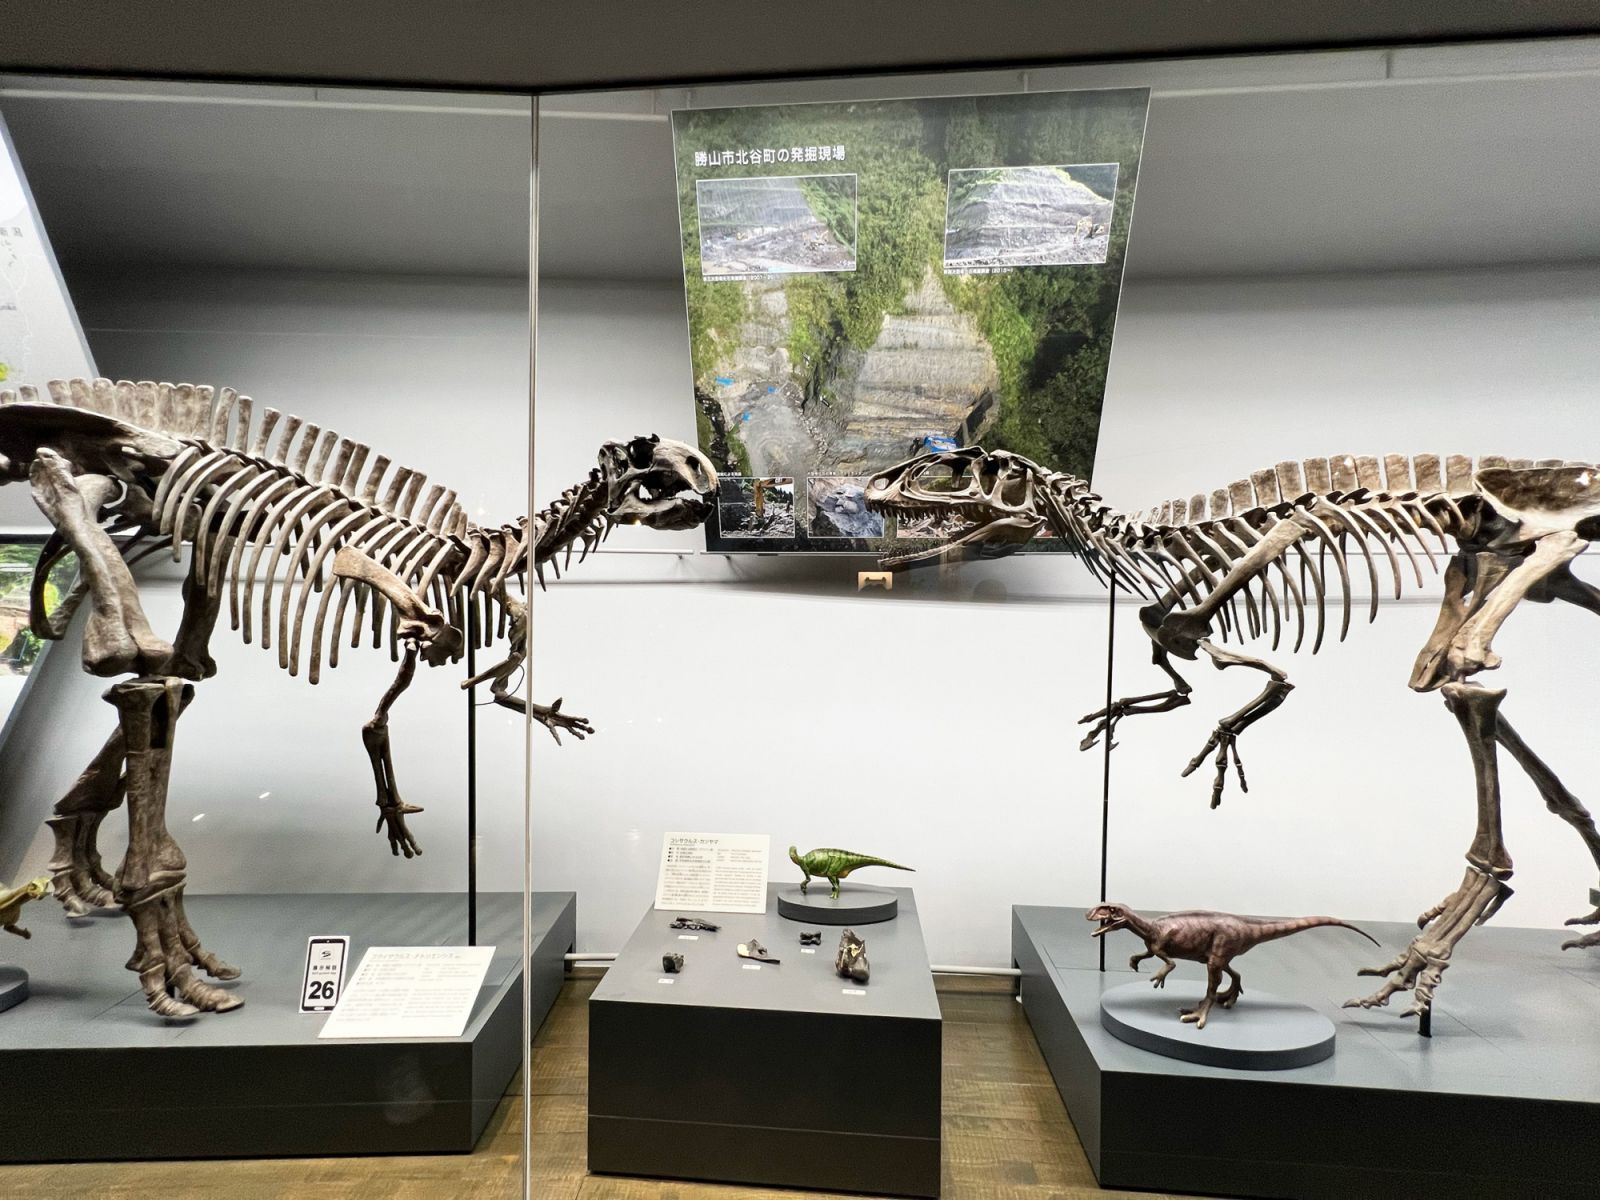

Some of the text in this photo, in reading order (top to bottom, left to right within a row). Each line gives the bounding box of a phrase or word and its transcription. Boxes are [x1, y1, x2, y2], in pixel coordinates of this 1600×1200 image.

[694, 145, 846, 167] 勝山市北谷町の発掘現場
[308, 980, 335, 1000] 26
